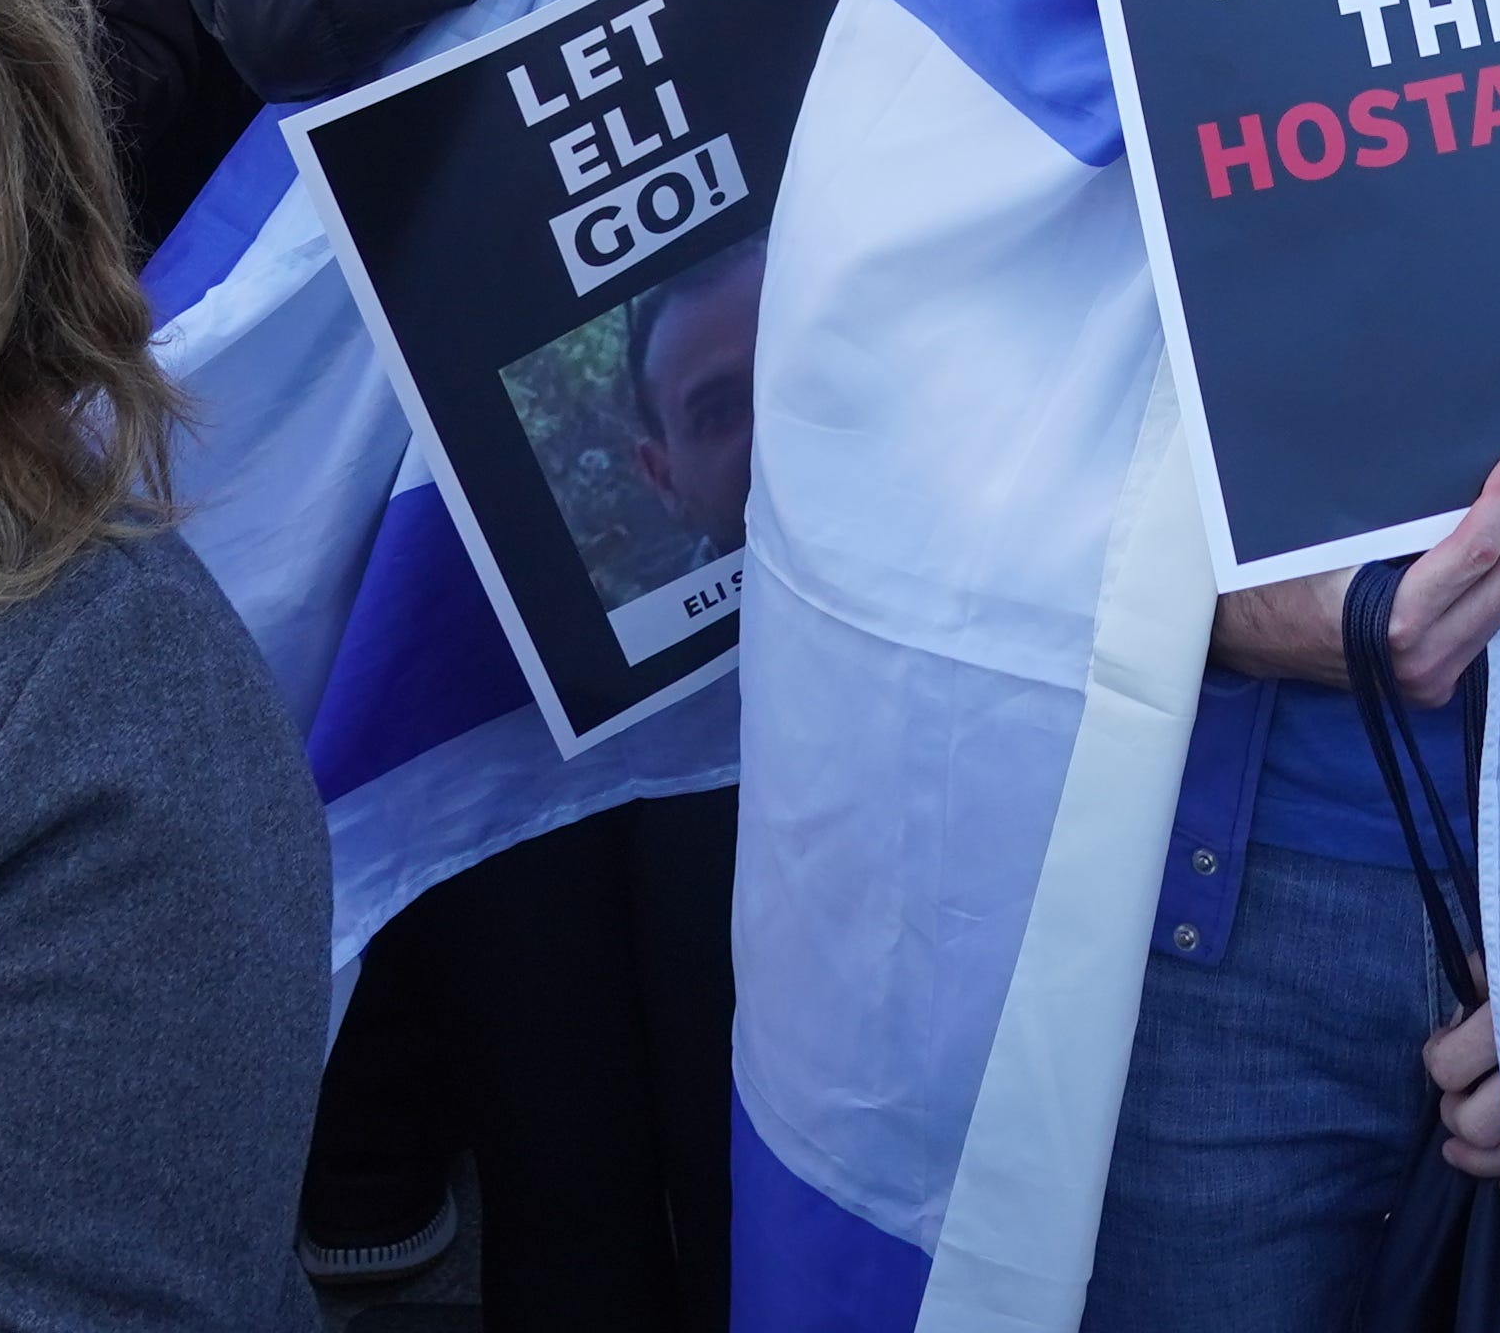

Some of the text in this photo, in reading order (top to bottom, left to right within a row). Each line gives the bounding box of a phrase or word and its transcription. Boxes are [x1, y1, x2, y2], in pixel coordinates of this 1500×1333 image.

[548, 79, 692, 197] ELI
[574, 148, 727, 270] GO!
[682, 579, 727, 620] ELI
